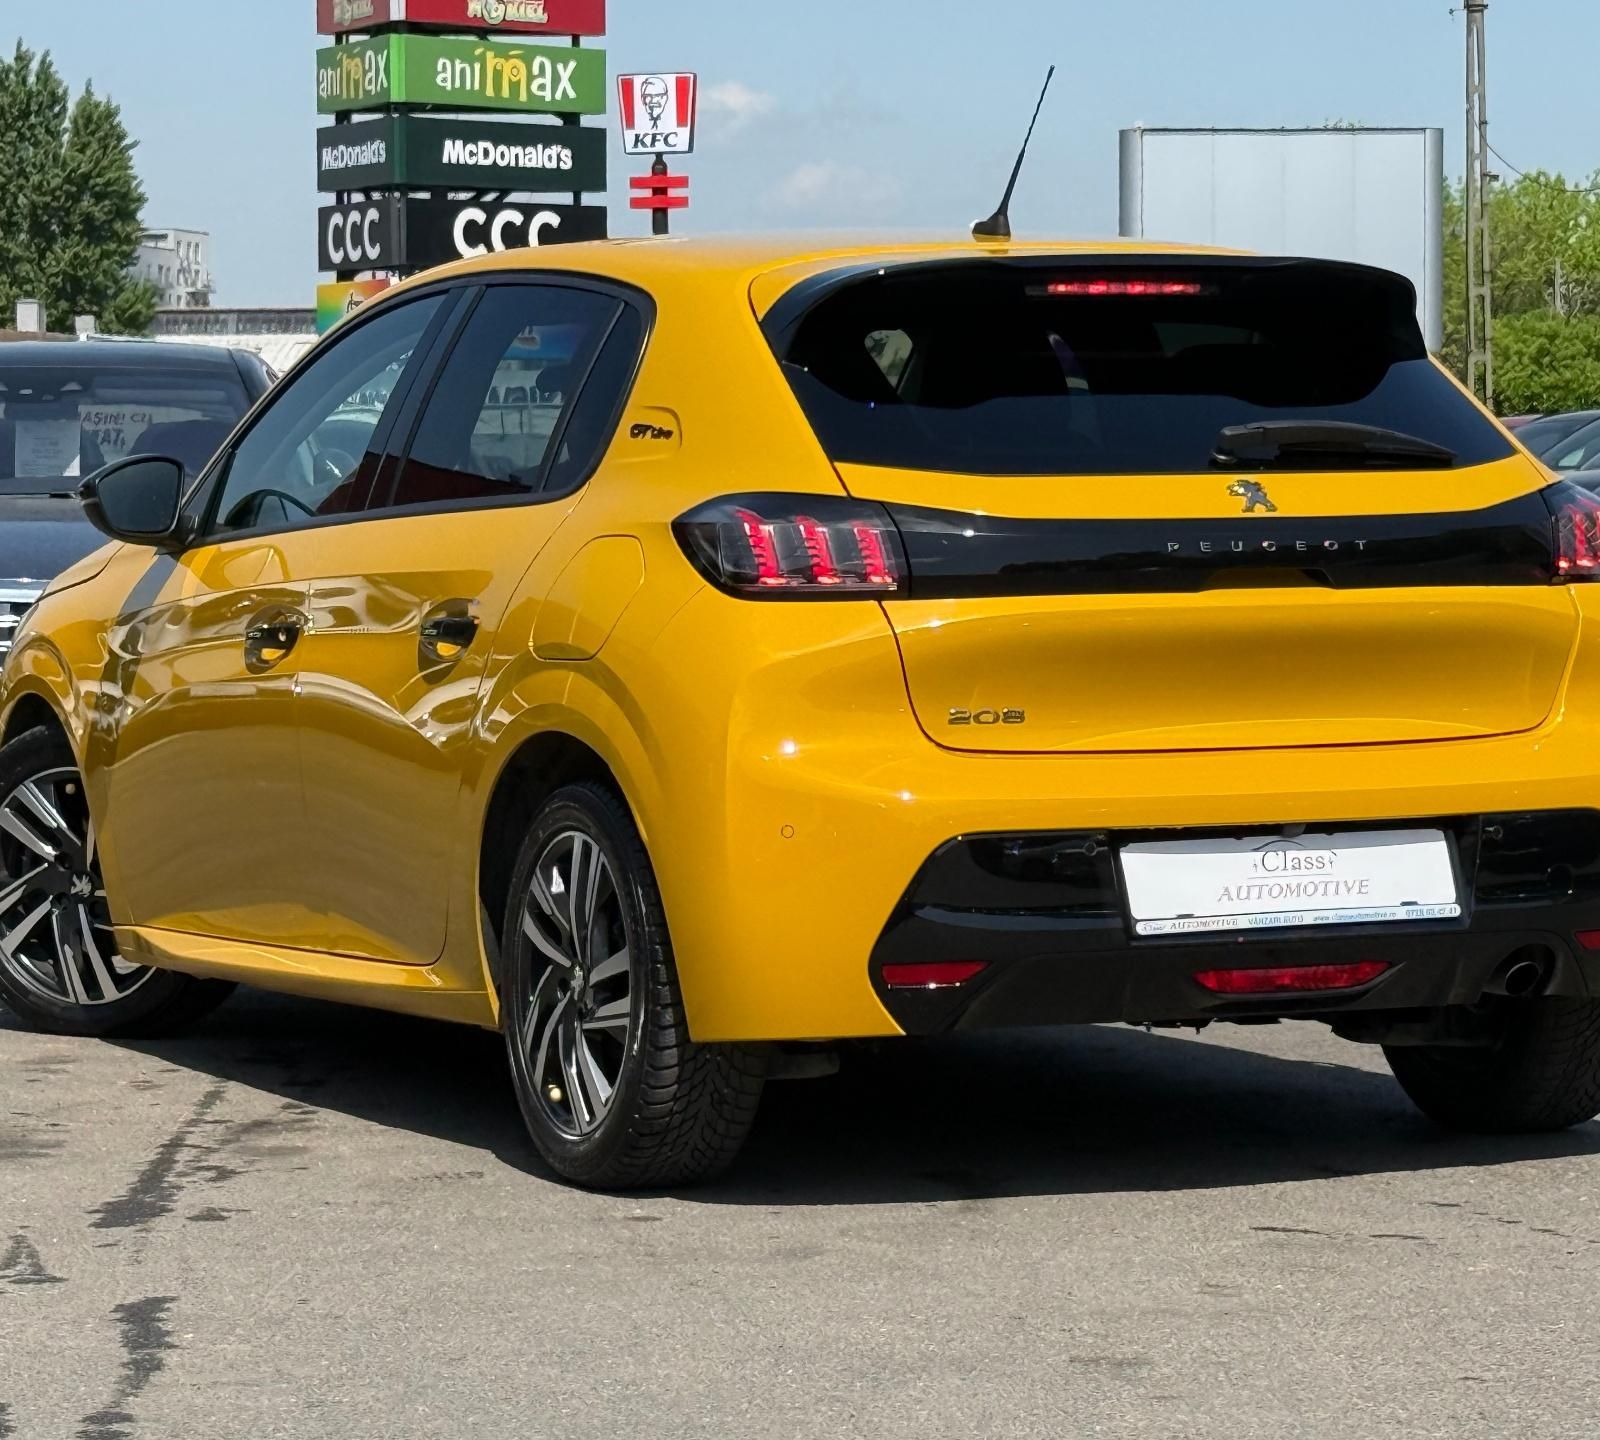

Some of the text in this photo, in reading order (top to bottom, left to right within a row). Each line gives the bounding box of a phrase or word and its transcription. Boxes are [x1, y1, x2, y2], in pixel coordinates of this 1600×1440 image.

[319, 49, 389, 99] animax
[436, 48, 578, 102] animax
[321, 139, 386, 171] McDonald's
[442, 138, 573, 170] McDonald's
[631, 131, 679, 149] KFC
[328, 207, 381, 264] CCC
[453, 207, 561, 258] CCC
[1167, 539, 1367, 553] PEUGEOT
[948, 707, 1026, 725] 208
[1261, 850, 1326, 872] Class
[1217, 879, 1370, 902] AUTOMOTIVE
